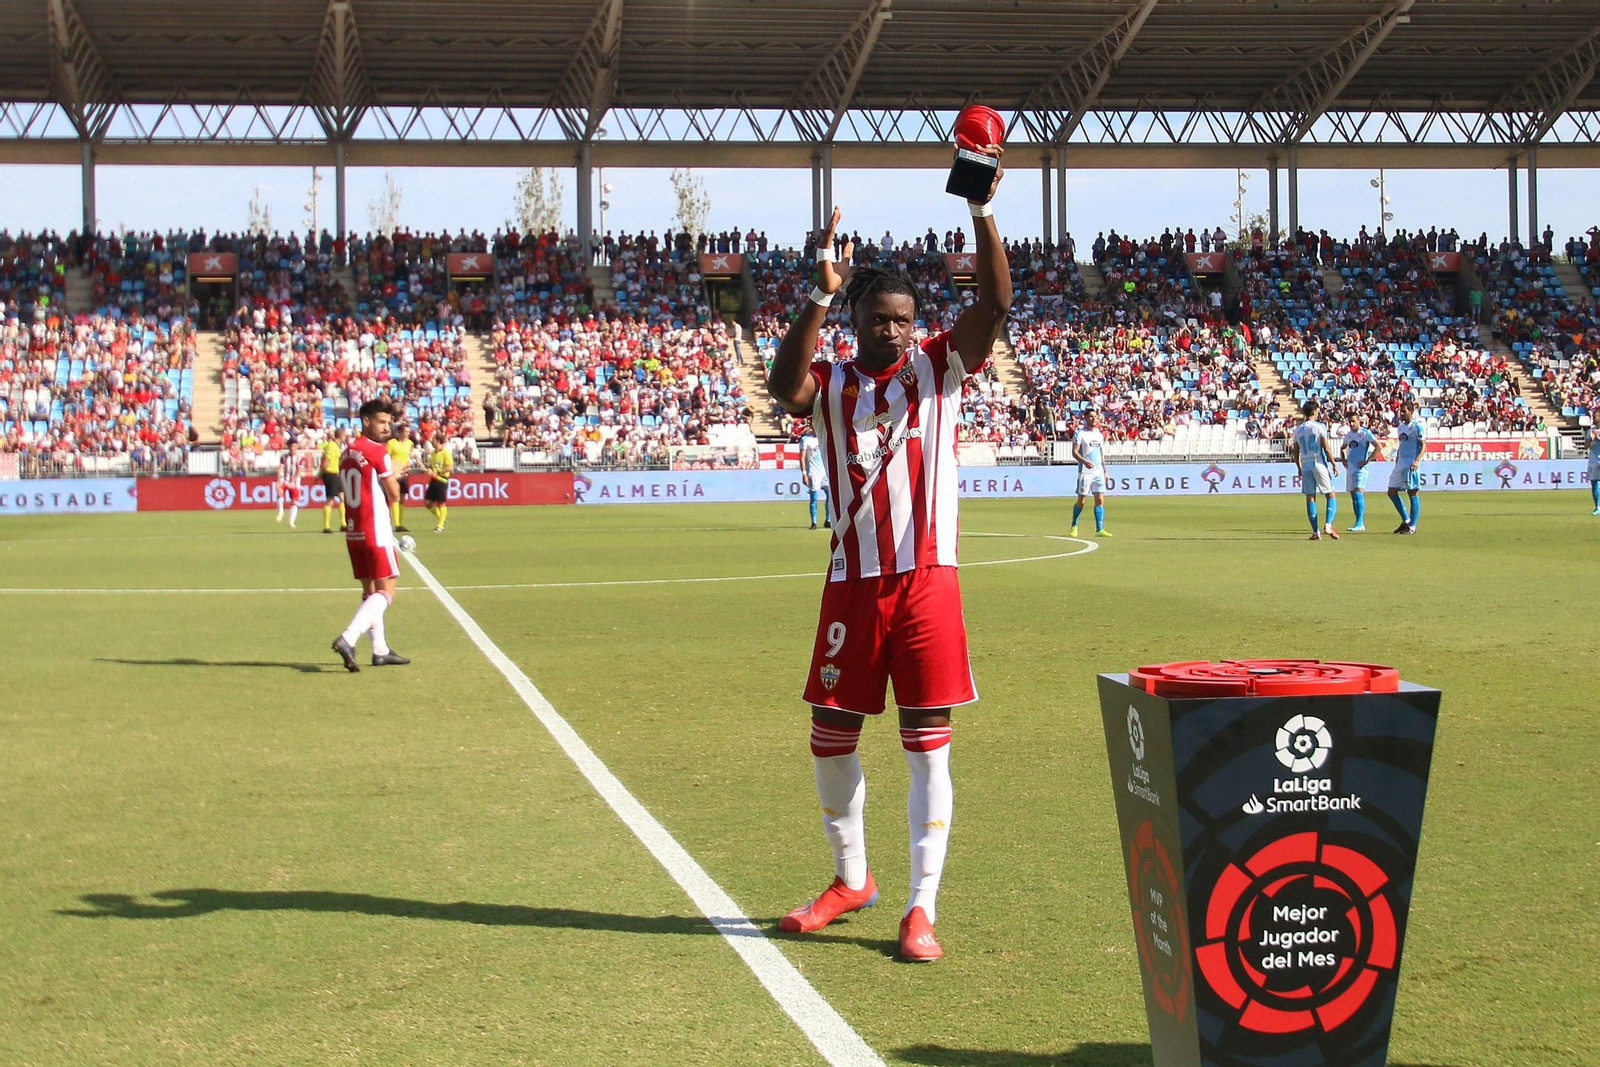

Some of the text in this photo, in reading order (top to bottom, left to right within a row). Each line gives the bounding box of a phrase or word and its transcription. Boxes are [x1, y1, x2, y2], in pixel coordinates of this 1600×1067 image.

[846, 446, 888, 465] Arabian
[1424, 451, 1514, 460] UERCALENSE
[1444, 443, 1482, 452] PEÑA
[957, 475, 1023, 492] MERÍA
[1106, 476, 1190, 490] OSTADE
[1232, 475, 1302, 488] ALMER
[1420, 472, 1483, 485] STADE
[1523, 471, 1589, 484] ALMER
[600, 479, 704, 498] ALMERÍA
[0, 492, 113, 506] COSTADE
[825, 622, 846, 657] 9
[1274, 776, 1331, 794] LaLiga
[1266, 794, 1361, 812] SmartBank
[1150, 888, 1162, 907] MVP
[1273, 904, 1328, 925] Mejor
[1259, 927, 1339, 949] Jugador
[1261, 951, 1335, 969] del Mes
